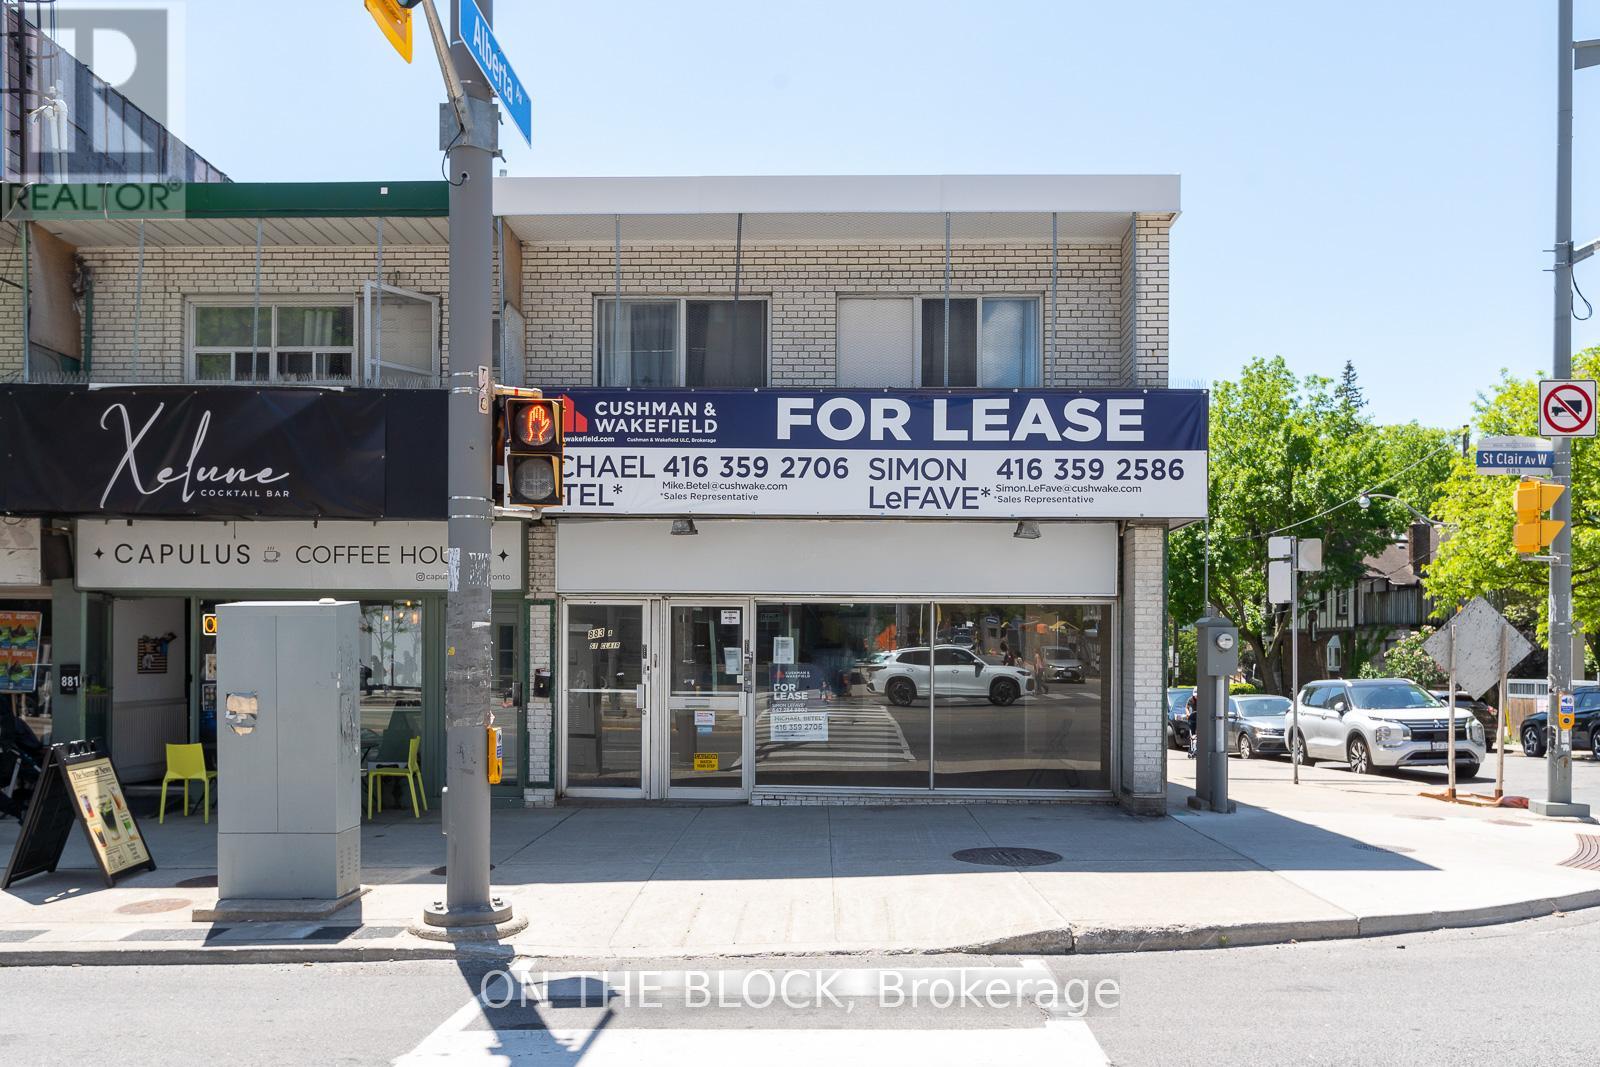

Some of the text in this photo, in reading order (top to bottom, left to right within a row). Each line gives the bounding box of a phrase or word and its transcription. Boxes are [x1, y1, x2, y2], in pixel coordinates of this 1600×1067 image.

[473, 15, 513, 105] Alberta
[594, 401, 717, 417] CUSHMAN &
[594, 418, 718, 433] WAKEFIELD
[777, 398, 1145, 442] FOR LEASE
[563, 435, 615, 443] wakefield.com
[100, 402, 290, 509] Xelune
[1482, 452, 1548, 465] St Clair Av W
[564, 455, 849, 479] CHAEL 416 359 2706
[868, 457, 1185, 481] SIMON 416 359 2586
[662, 481, 788, 491] Mike.Betel@cushwake.com
[995, 484, 1142, 493] Simon.LeFave@cushwake.com
[200, 489, 290, 498] COCKTAIL BAR
[564, 484, 623, 506] TEL
[690, 492, 759, 502] Representative
[1024, 495, 1095, 504] Representative
[114, 543, 449, 565] CAPULUS COFFEE HOU
[588, 628, 604, 639] 883
[61, 675, 79, 687] 881
[773, 683, 797, 692] FOR
[773, 692, 809, 701] LEASE
